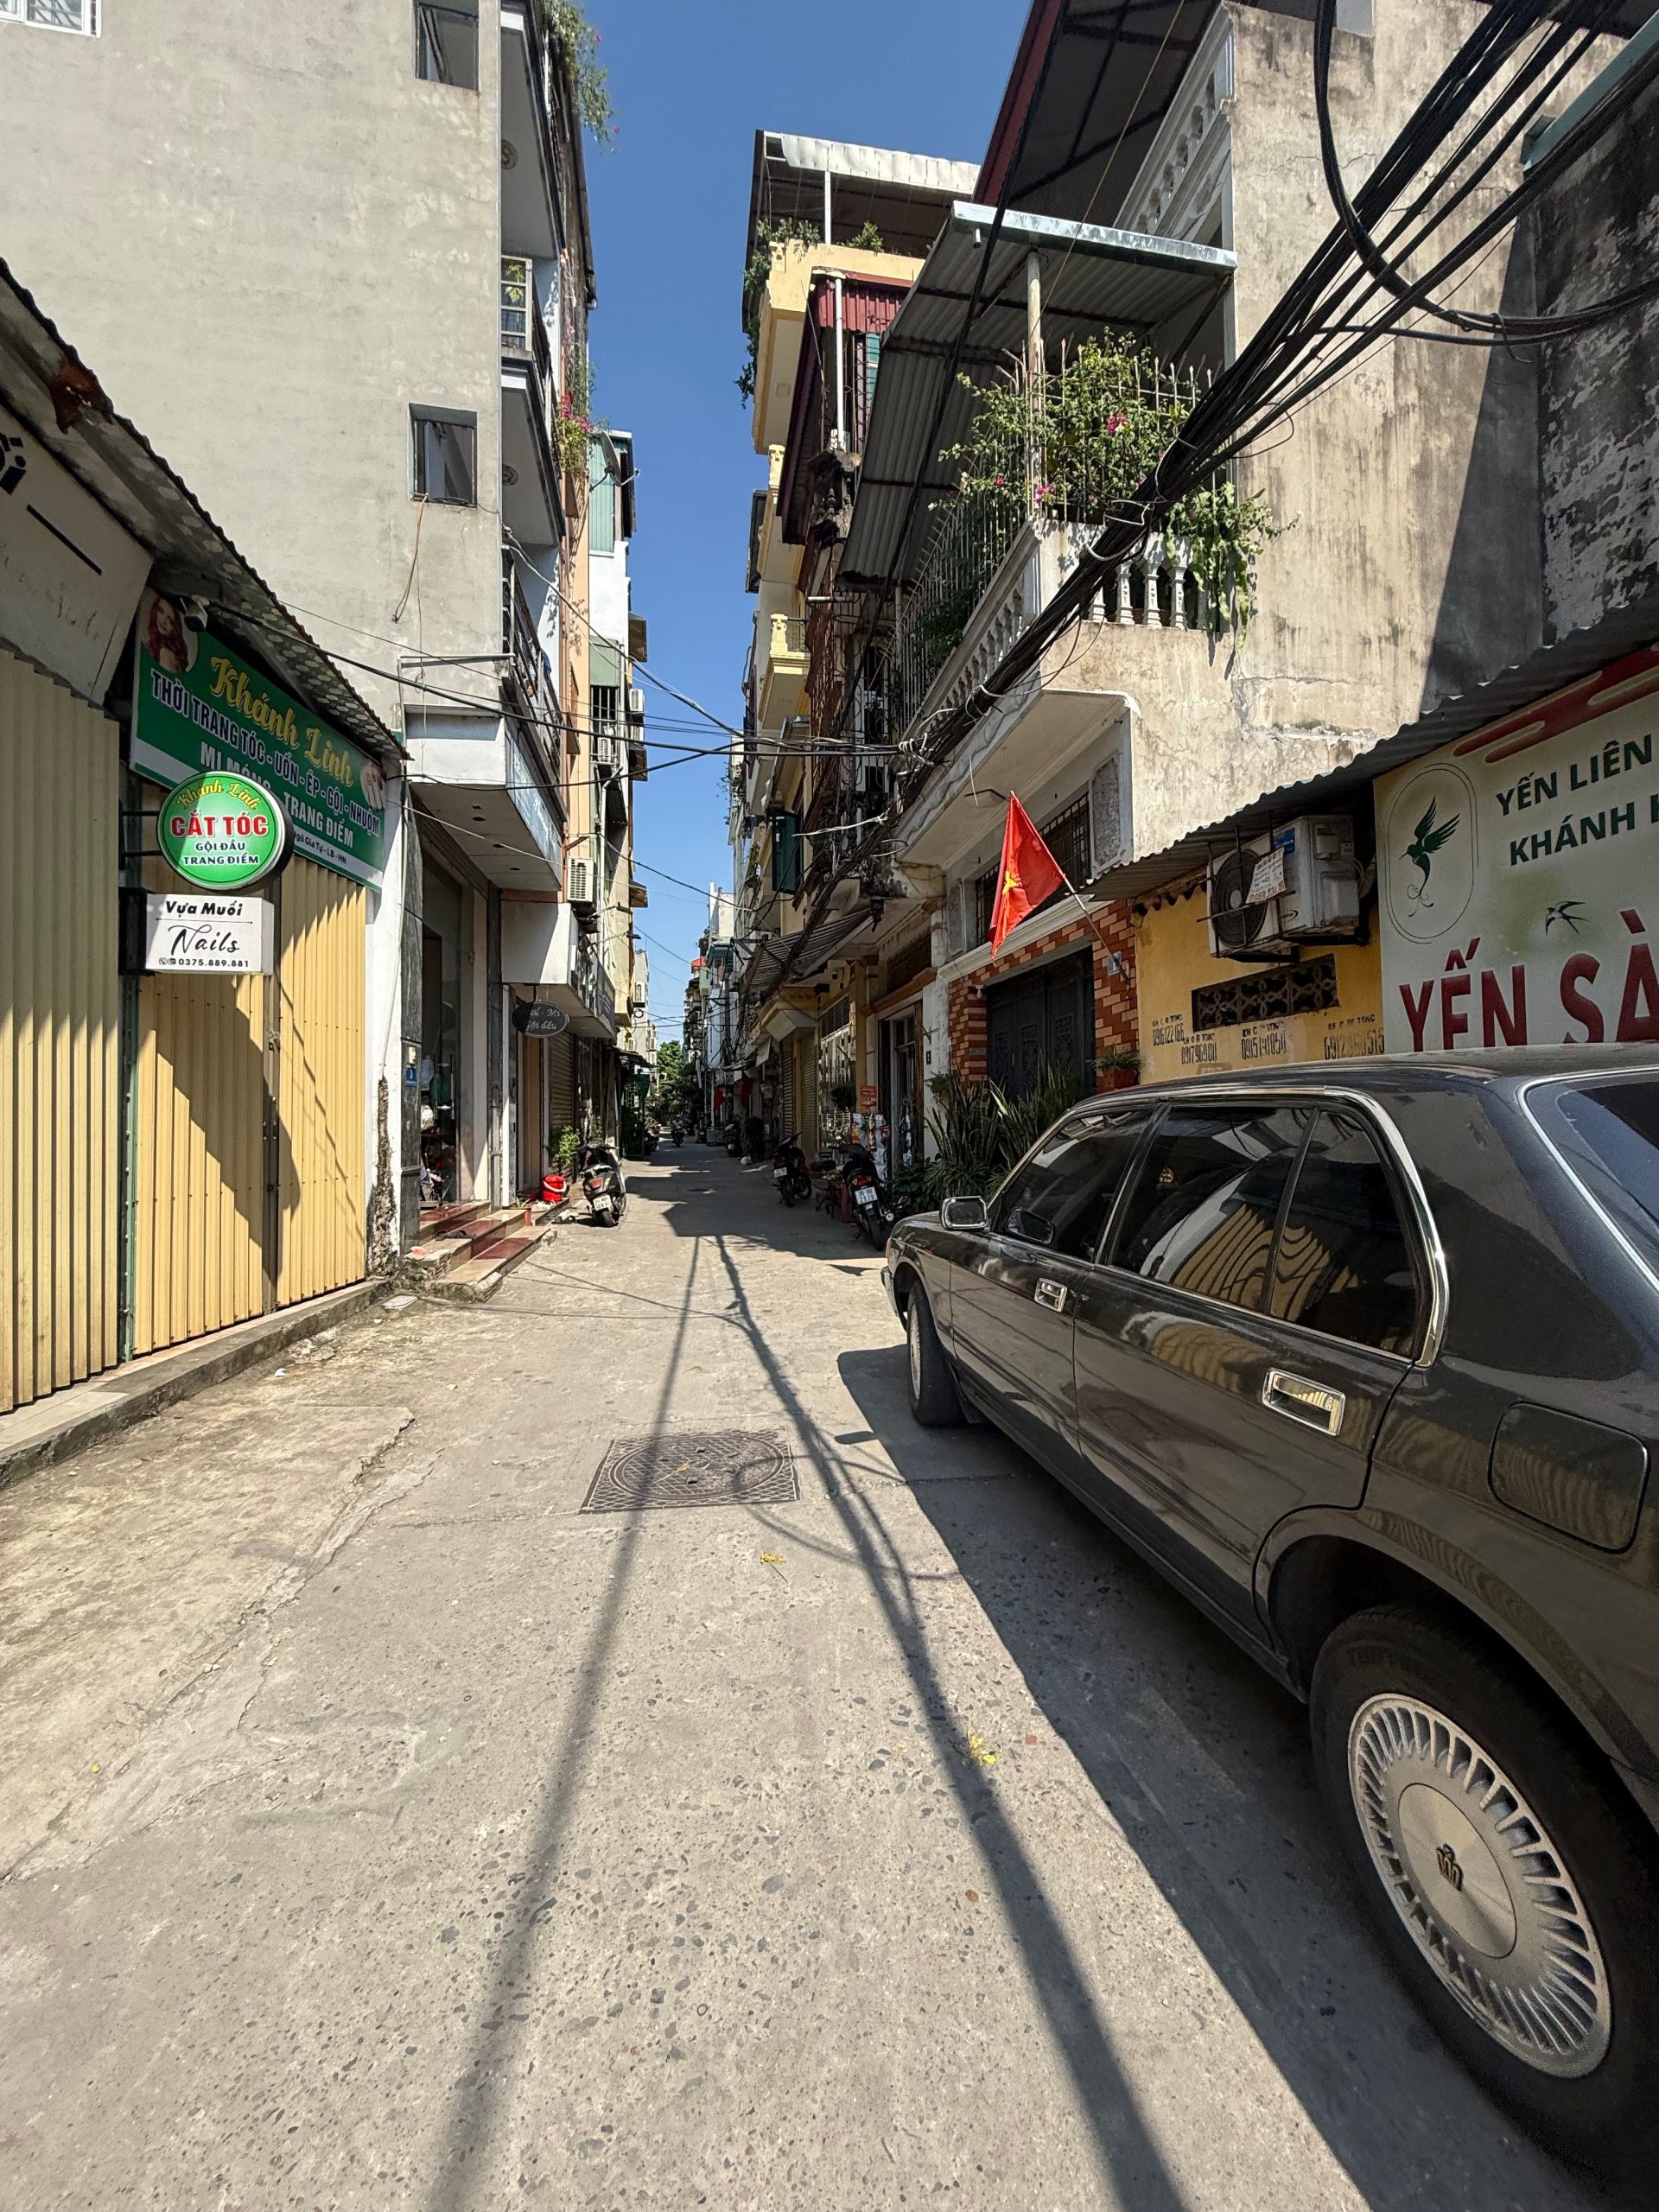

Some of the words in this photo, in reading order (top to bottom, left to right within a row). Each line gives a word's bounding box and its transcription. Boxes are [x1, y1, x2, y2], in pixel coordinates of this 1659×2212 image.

[210, 656, 300, 750] Khánh
[304, 727, 353, 787] Linh
[151, 668, 189, 718] THỜI
[191, 695, 238, 749] TRANG
[240, 727, 265, 765] TÓC
[274, 749, 299, 786] UỐN
[306, 768, 321, 798] ÉP
[327, 785, 344, 816] GỘI
[349, 800, 380, 836] NHUỘM
[1496, 772, 1558, 816] YẾN
[1570, 734, 1652, 791] LIÊN
[177, 779, 223, 809] Khánh
[226, 782, 261, 810] Linh
[200, 741, 221, 770] MI
[283, 791, 323, 832] TRANG
[326, 817, 353, 849] ĐIỂM
[171, 809, 216, 837] CẮT
[222, 812, 268, 837] TÓC
[1510, 802, 1635, 866] KHÁNH
[183, 856, 225, 865] TRANG
[227, 852, 258, 864] ĐIỂM
[195, 841, 217, 852] GỘI
[166, 900, 197, 918] Vựa
[200, 900, 244, 916] Muối
[168, 925, 240, 956] Nails
[178, 958, 249, 968] 0375.889.881
[1399, 937, 1528, 1052] YẾN
